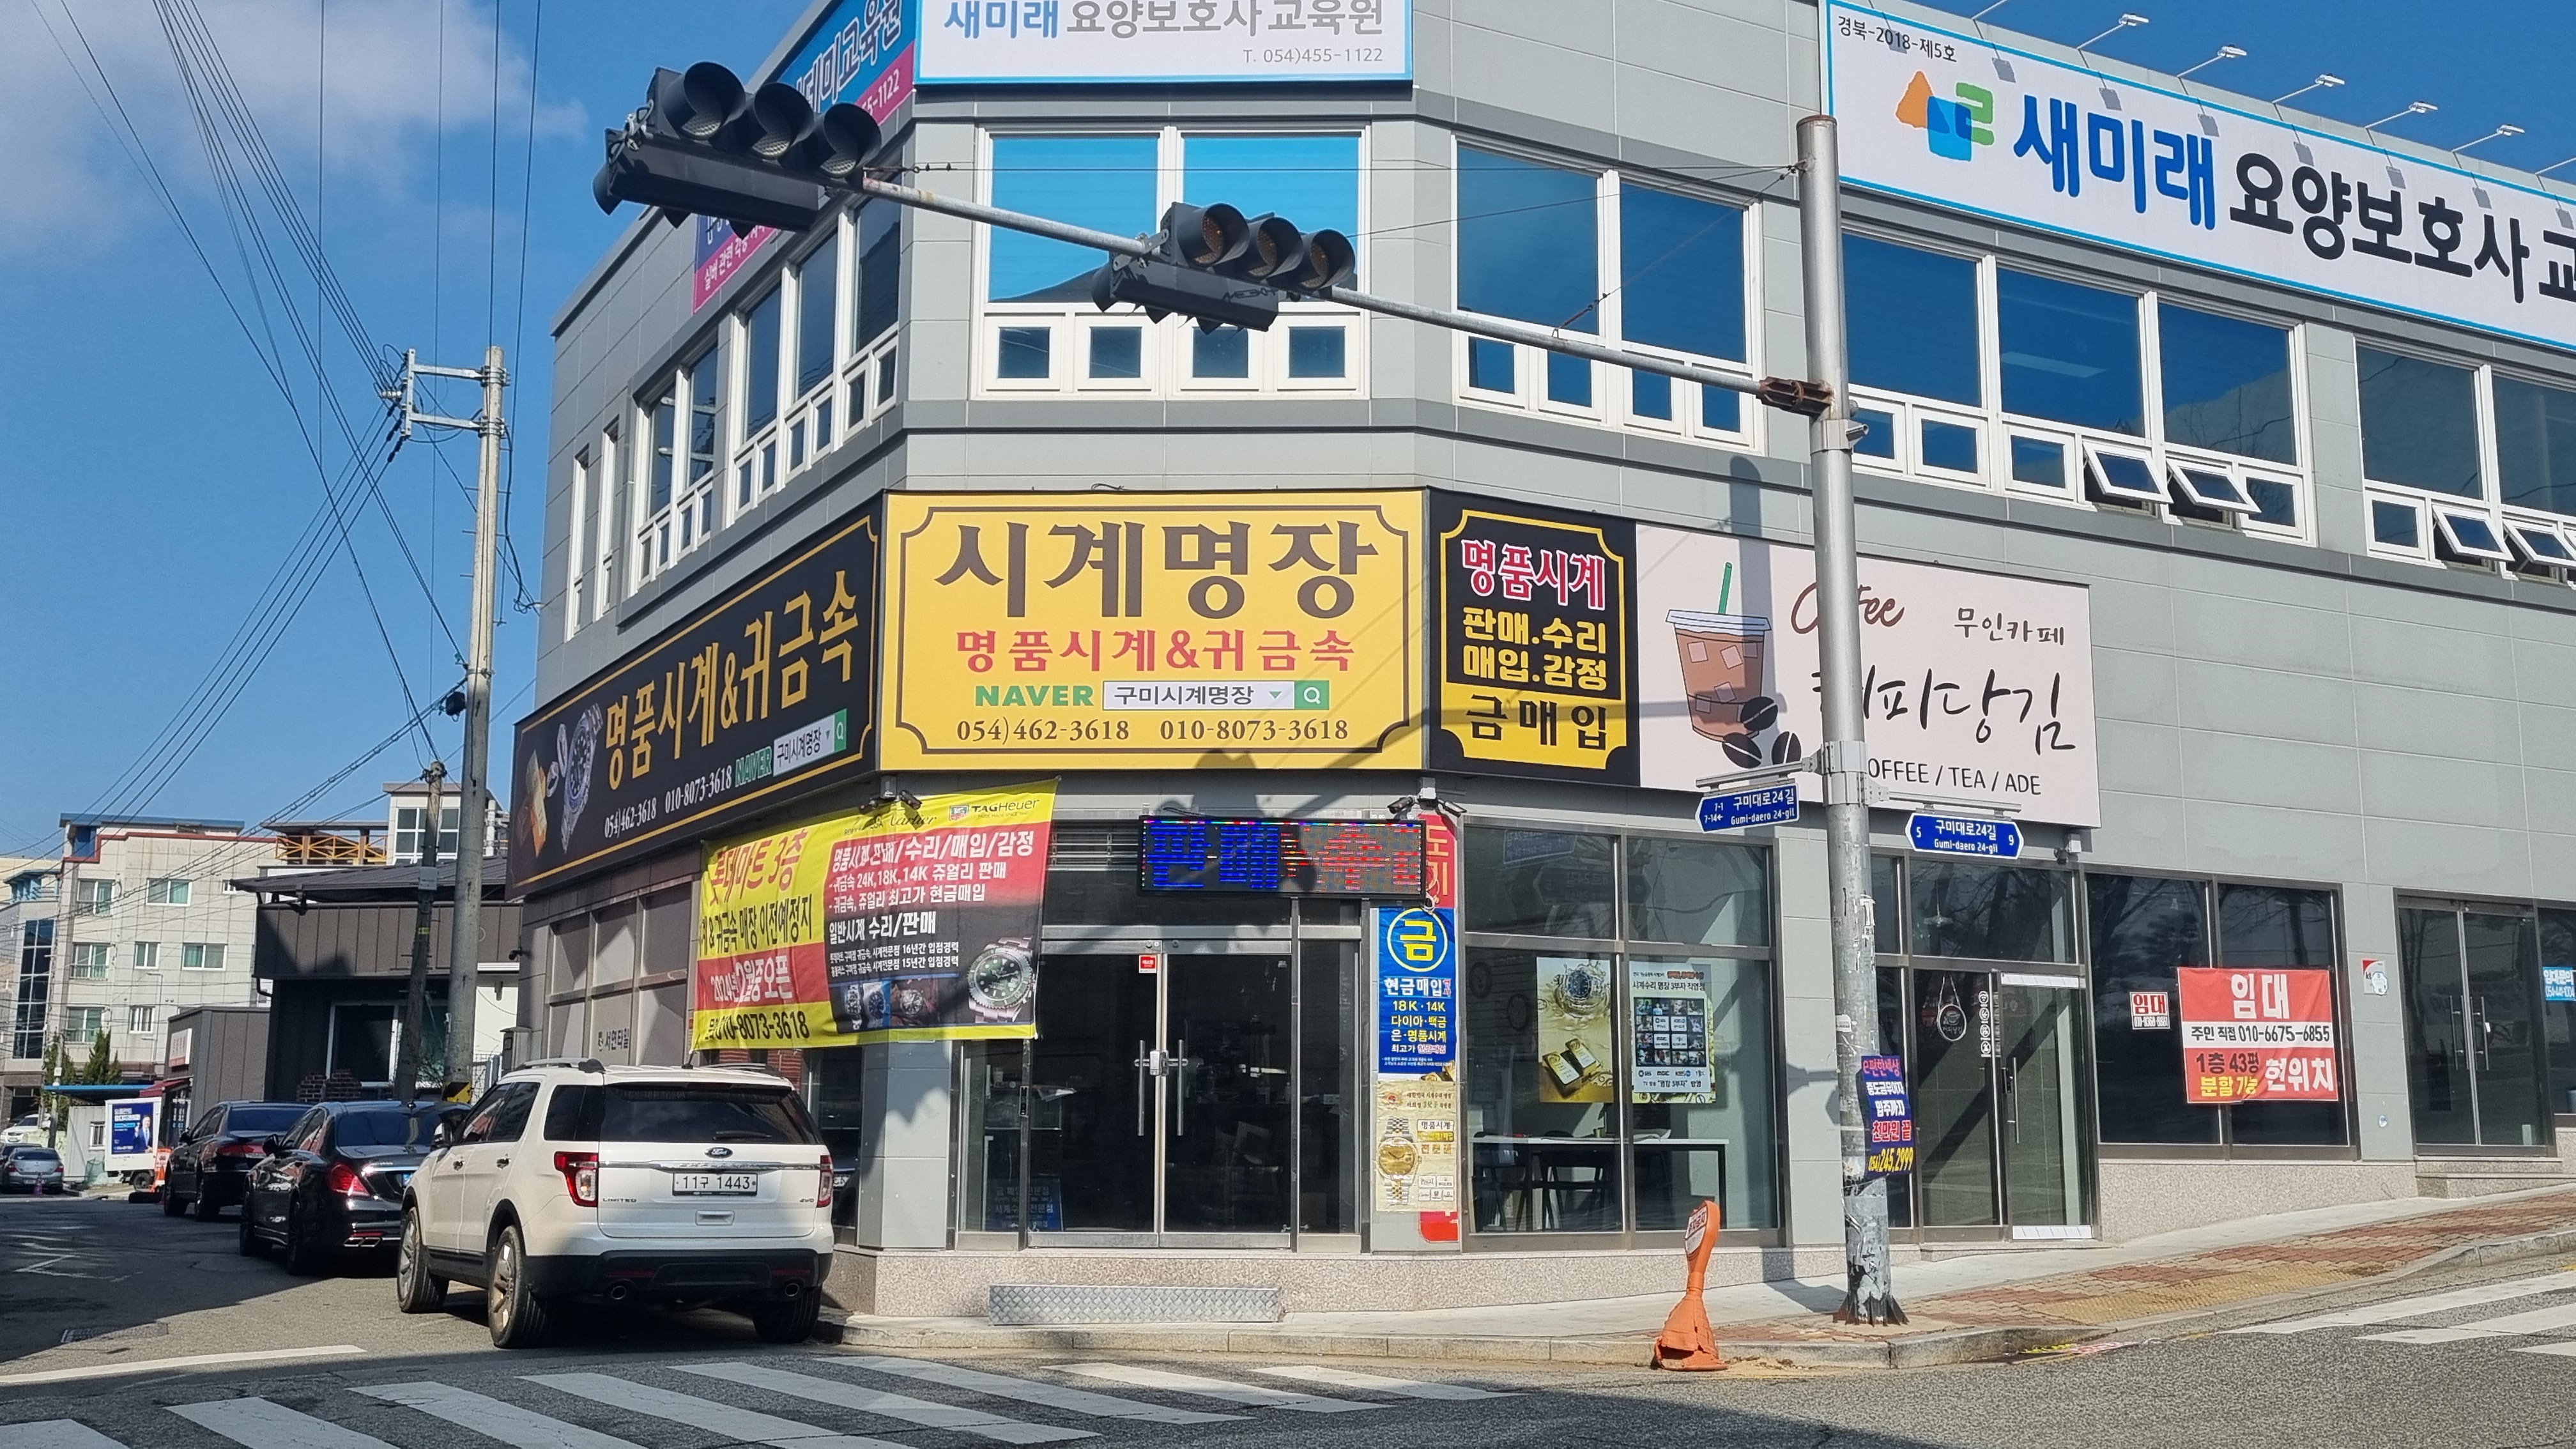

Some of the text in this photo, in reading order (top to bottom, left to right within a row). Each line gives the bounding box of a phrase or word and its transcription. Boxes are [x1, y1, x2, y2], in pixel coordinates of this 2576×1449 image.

[944, 0, 1383, 39] 새미래 요양보호사 교육원
[1838, 15, 1957, 63] 경북-2018-제5호
[1243, 48, 1383, 64] T. 054)455-1122
[2013, 94, 2216, 230] 새미래
[2229, 153, 2530, 303] 요양보호사
[935, 521, 1379, 618] 시계명장
[1461, 539, 1606, 611] 명품시계
[1954, 608, 2064, 645] 무인카페
[957, 629, 1355, 673] 명품시계&귀금속
[606, 571, 859, 790] 명품시계&귀금속
[975, 686, 1093, 706] NAVER
[1114, 686, 1254, 705] 구미시계명장
[957, 716, 1349, 745] 054)462-3618 010-8073-3618
[776, 726, 822, 767] 구미시계명장
[735, 746, 773, 788] NAVER
[1868, 758, 1930, 783] OFFEE
[1948, 767, 1986, 789] TEA
[2005, 773, 2041, 795] ADE
[604, 765, 732, 839] 054)462-3618 010-8073-3618
[1733, 788, 1795, 811] 구미대로24길
[1731, 808, 1795, 825] Gumi-daero 24-gil
[1935, 820, 1997, 841] 구미대로24길
[1935, 839, 1998, 854] Gumi-daero 24-gil
[2008, 835, 2014, 845] 9
[768, 829, 808, 891] 3층
[932, 862, 974, 881] 쥬얼리
[978, 862, 1007, 880] 판매
[859, 891, 885, 910] 쥬얼리
[888, 885, 926, 906] 최고가
[930, 884, 985, 903] 현금매입
[739, 905, 757, 949] 매장
[829, 911, 937, 945] 일반시계 수리/판매
[1399, 920, 1437, 962] 금
[902, 943, 926, 954] 16년간
[928, 942, 959, 954] 입점경력
[902, 956, 926, 968] 15년간
[928, 955, 959, 968] 입점경력
[764, 955, 793, 999] 오픈
[2133, 994, 2166, 1014] 임대
[2231, 973, 2290, 1019] 임대
[2191, 1025, 2330, 1042] 주민 직접 010-6675-6855
[2196, 1052, 2259, 1074] 1층 43평
[2265, 1057, 2334, 1092] 현위치
[1866, 1081, 1905, 1096] 중도금무이자
[2200, 1076, 2234, 1097] 분할
[1872, 1120, 1911, 1142] 천만원 끝
[717, 1176, 750, 1190] 1443
